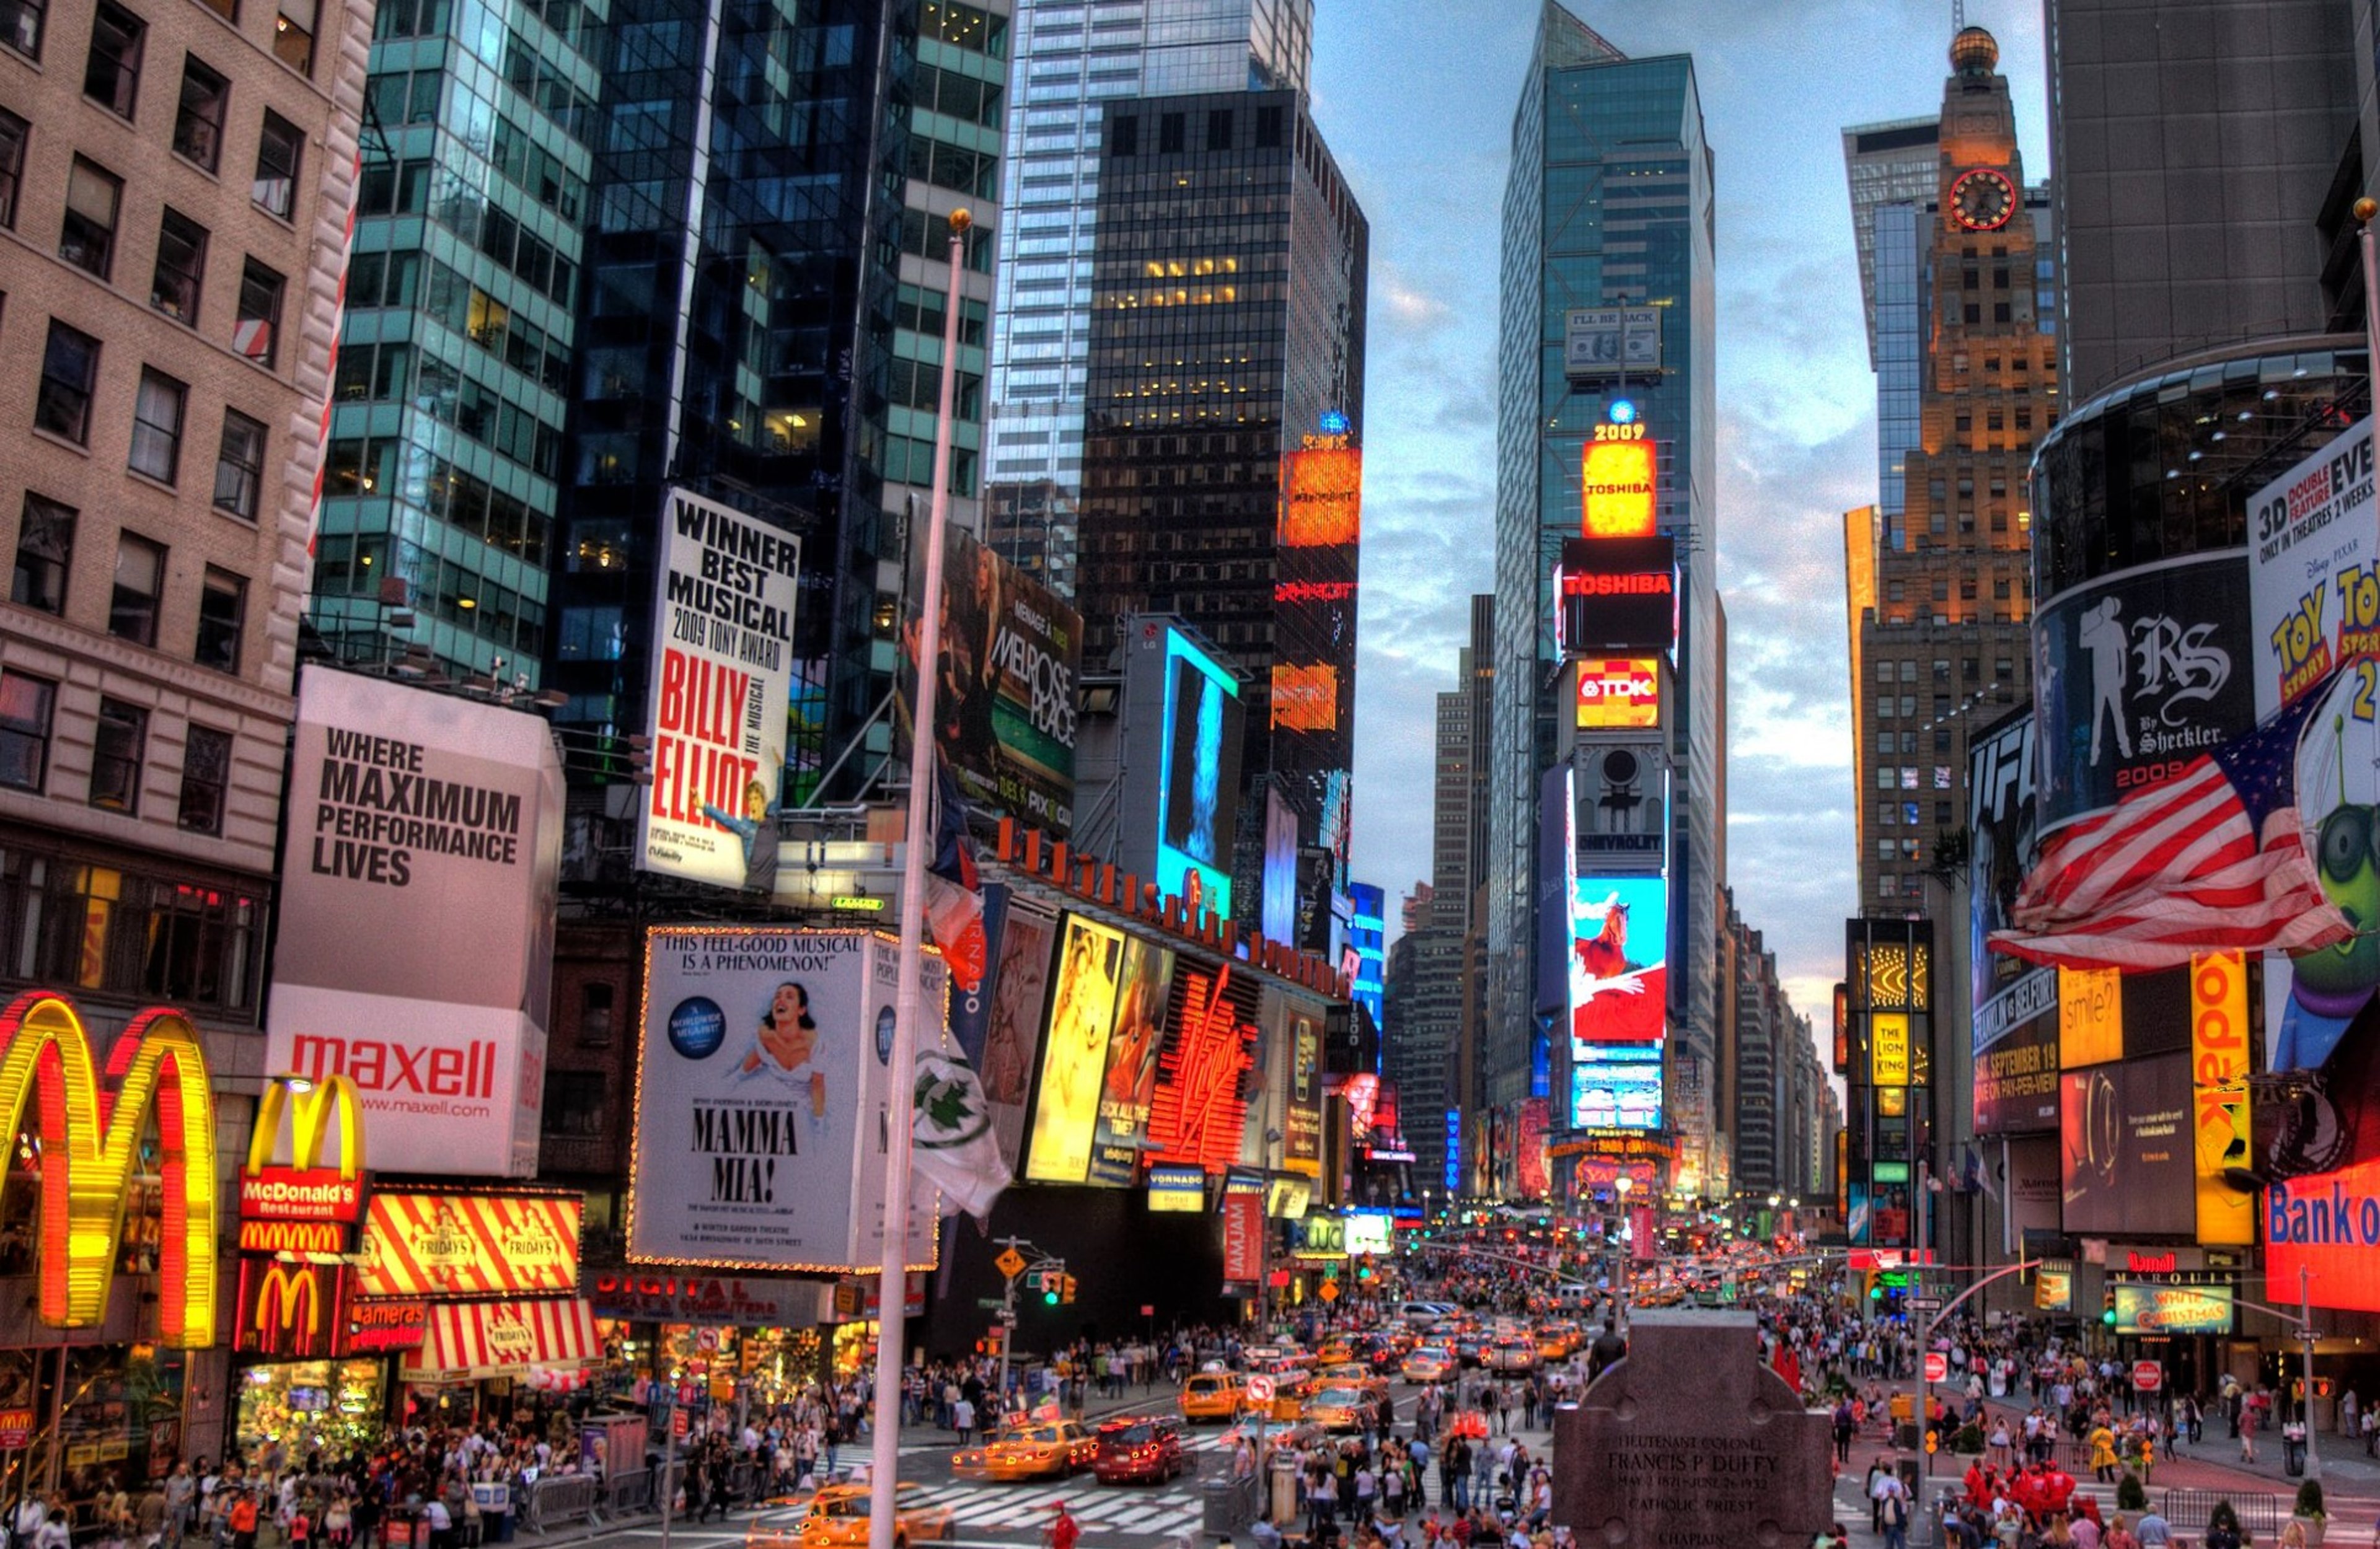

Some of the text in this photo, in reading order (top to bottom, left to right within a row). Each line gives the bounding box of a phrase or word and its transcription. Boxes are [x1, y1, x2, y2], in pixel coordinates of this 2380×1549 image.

[1573, 316, 1596, 325] I'LL
[1600, 315, 1616, 323] BE
[1594, 424, 1645, 442] 2009
[1587, 483, 1653, 495] TOSHIBA
[2288, 465, 2329, 504] DOUBLE
[2289, 484, 2330, 524] FEATURE
[2259, 496, 2288, 542] 3D
[2260, 477, 2376, 564] ONLY IN THEATRES 2 WEEKS.
[675, 496, 797, 579] WINNER
[700, 547, 769, 599] BEST
[1563, 573, 1672, 595] TOSHIBA
[668, 569, 790, 643] MUSICAL
[673, 607, 780, 672] 2009 TONY AWARD
[2270, 578, 2327, 680] TOY
[1143, 640, 1157, 649] LG
[991, 625, 1072, 708] MELROSE
[2284, 649, 2325, 701] STORY
[659, 647, 750, 750] BILLY
[1597, 678, 1654, 697] TDK
[2351, 657, 2377, 724] 2
[746, 677, 765, 755] THE MUSICAL
[1030, 688, 1076, 749] PLACE
[327, 726, 425, 773] WHERE
[2138, 726, 2221, 755] Sheckler
[319, 758, 521, 834] MAXIMUM
[652, 734, 759, 835] ELLIOT
[315, 803, 518, 865] PERFORMANCE
[1577, 835, 1663, 851] CHEVROLET
[312, 836, 412, 887] LIVES
[703, 936, 787, 953] FEEL-GOOD
[793, 937, 861, 954] MUSICAL
[682, 955, 697, 970] IS
[700, 955, 711, 970] A
[1974, 997, 2008, 1048] FRANKLIN
[2015, 970, 2056, 1020] BELFORT
[2066, 981, 2114, 1029] smile?
[1880, 1028, 1900, 1038] THE
[1877, 1042, 1904, 1056] LION
[1990, 1045, 2040, 1078] SEPTEMBER
[2043, 1042, 2056, 1070] 19
[291, 1033, 496, 1099] maxell
[1877, 1059, 1905, 1077] KING
[361, 1095, 490, 1118] ww.maxell.com
[690, 1107, 798, 1156] MAMMA
[243, 1182, 355, 1203] McDonald's
[711, 1157, 775, 1203] MIA!
[1150, 1174, 1203, 1183] VORNADO
[259, 1201, 334, 1216] Restaurant
[2269, 1180, 2355, 1244] Bank
[420, 1240, 467, 1255] FRIDAY'S
[509, 1240, 552, 1255] FRIDAY'S
[597, 1275, 749, 1300] DIGITAL
[2115, 1272, 2233, 1285] MARQUIS
[2153, 1288, 2204, 1307] WHITE
[2137, 1301, 2226, 1329] CHRISTMAS
[1618, 1434, 1766, 1452] LIEUTENANT COLONEL
[1608, 1452, 1687, 1472] FRANCIS
[1712, 1455, 1781, 1473] DUFFY
[1618, 1475, 1642, 1486] MAY
[1628, 1498, 1755, 1512] CATHOLIC PRIEST
[1658, 1532, 1726, 1547] CHAPLAIN
